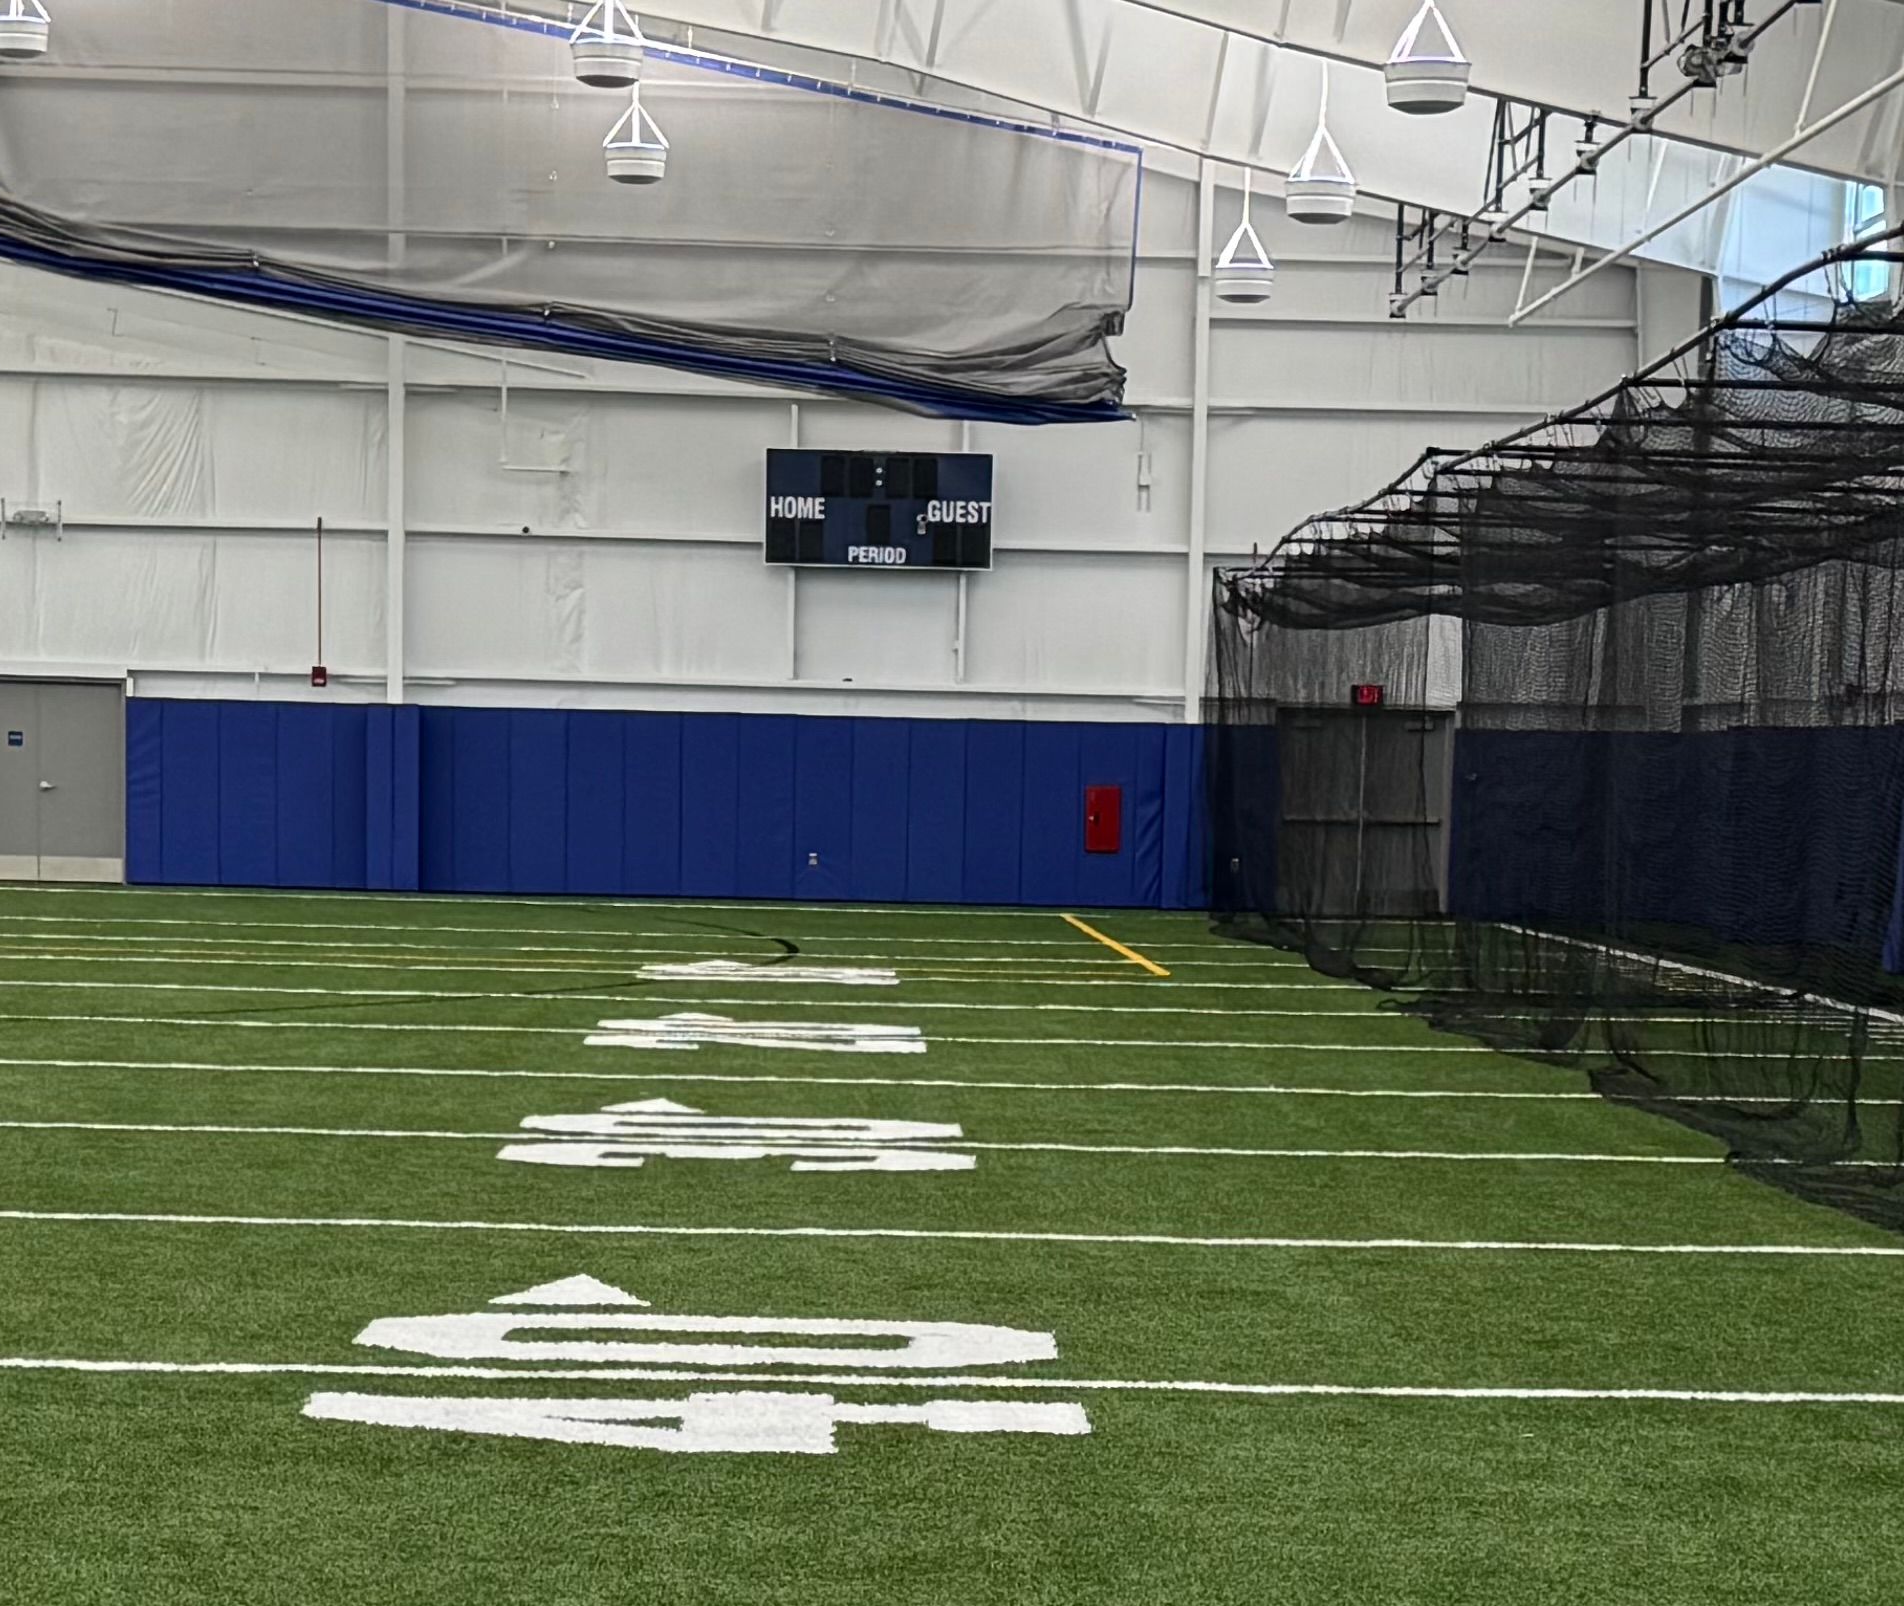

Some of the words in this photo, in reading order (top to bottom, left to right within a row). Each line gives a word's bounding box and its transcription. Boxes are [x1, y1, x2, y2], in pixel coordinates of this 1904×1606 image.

[770, 496, 825, 520] HOME
[927, 500, 991, 524] GUEST
[847, 546, 906, 564] PERIOD
[496, 1112, 978, 1172] 30
[301, 1311, 1093, 1455] 40
